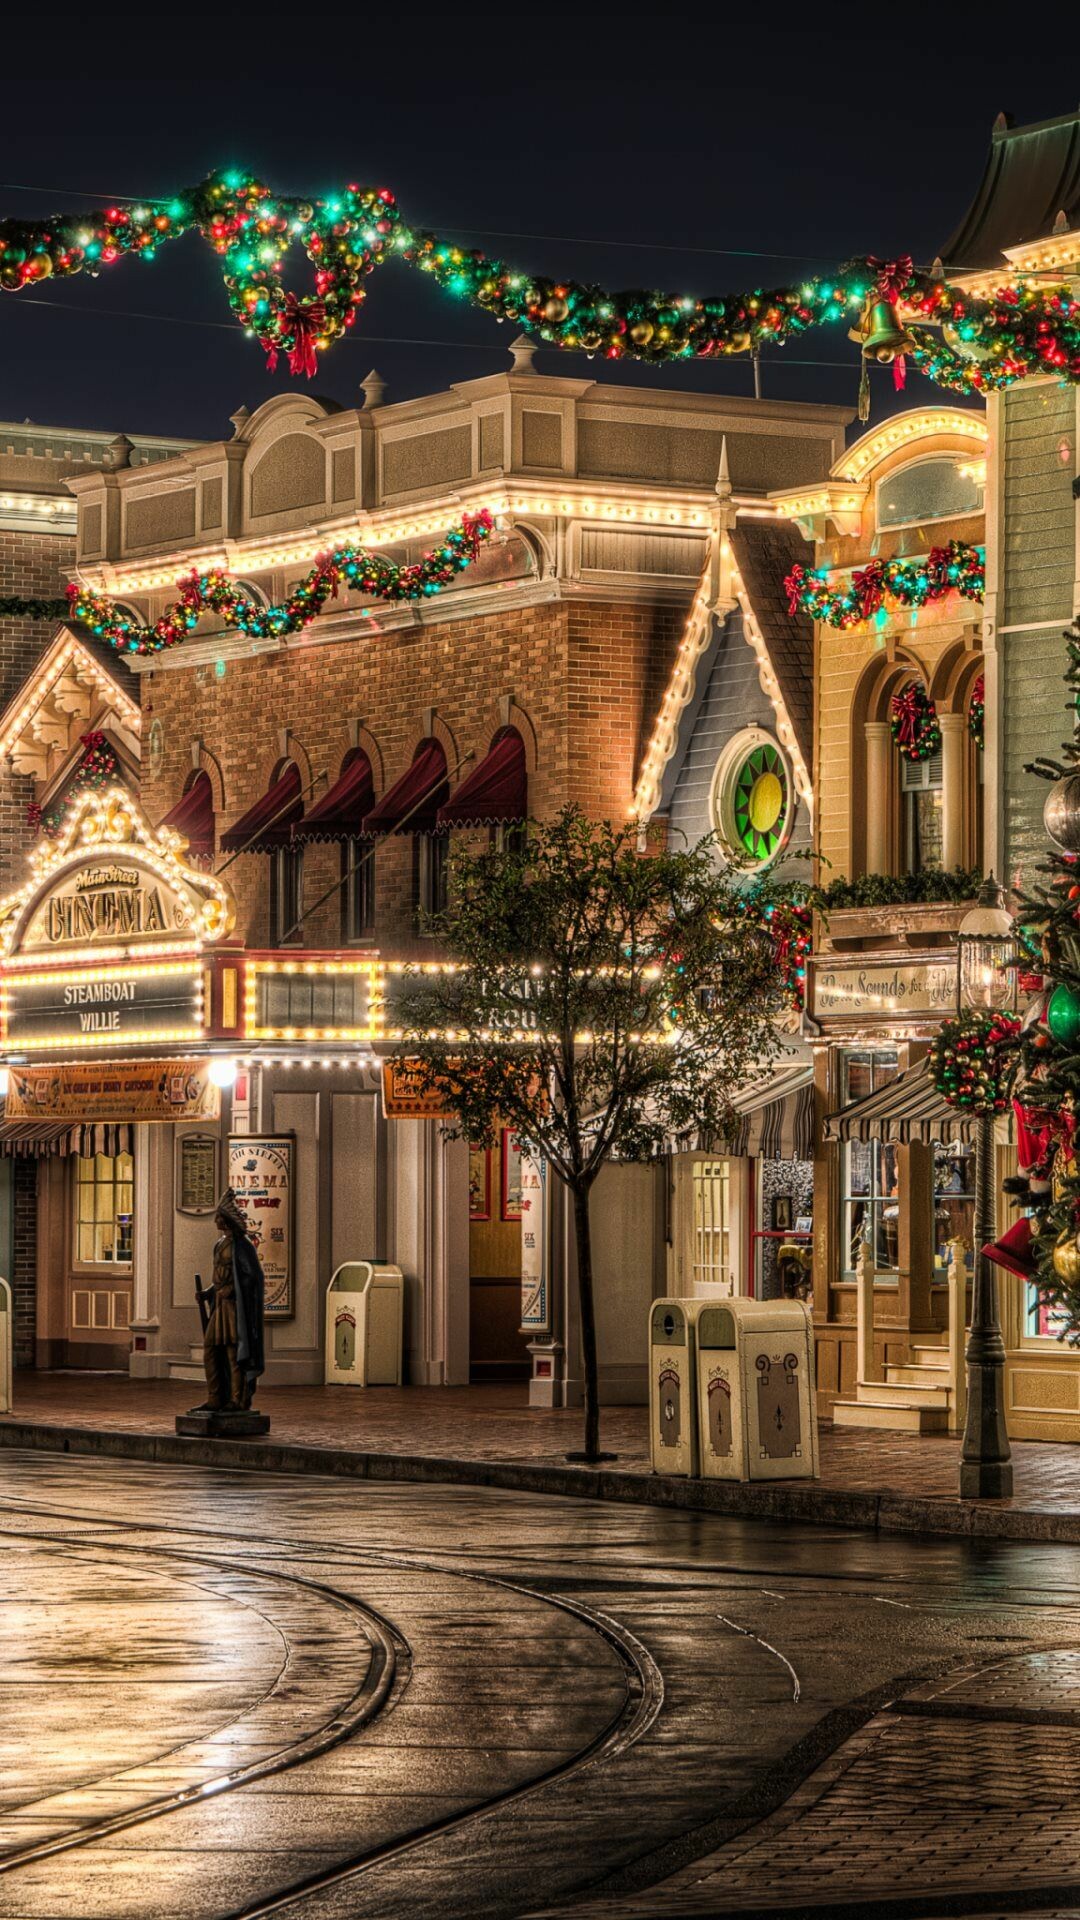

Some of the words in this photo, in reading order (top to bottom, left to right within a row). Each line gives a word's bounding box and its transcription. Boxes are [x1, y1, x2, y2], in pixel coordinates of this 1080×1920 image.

[76, 869, 105, 891] Main
[106, 865, 139, 885] Street
[45, 887, 167, 942] CINEMA
[64, 981, 137, 1005] STEAMBOAT
[855, 970, 906, 1007] Sounds
[908, 977, 923, 996] for
[80, 1010, 120, 1032] WILLIE
[229, 1175, 288, 1188] INEMA
